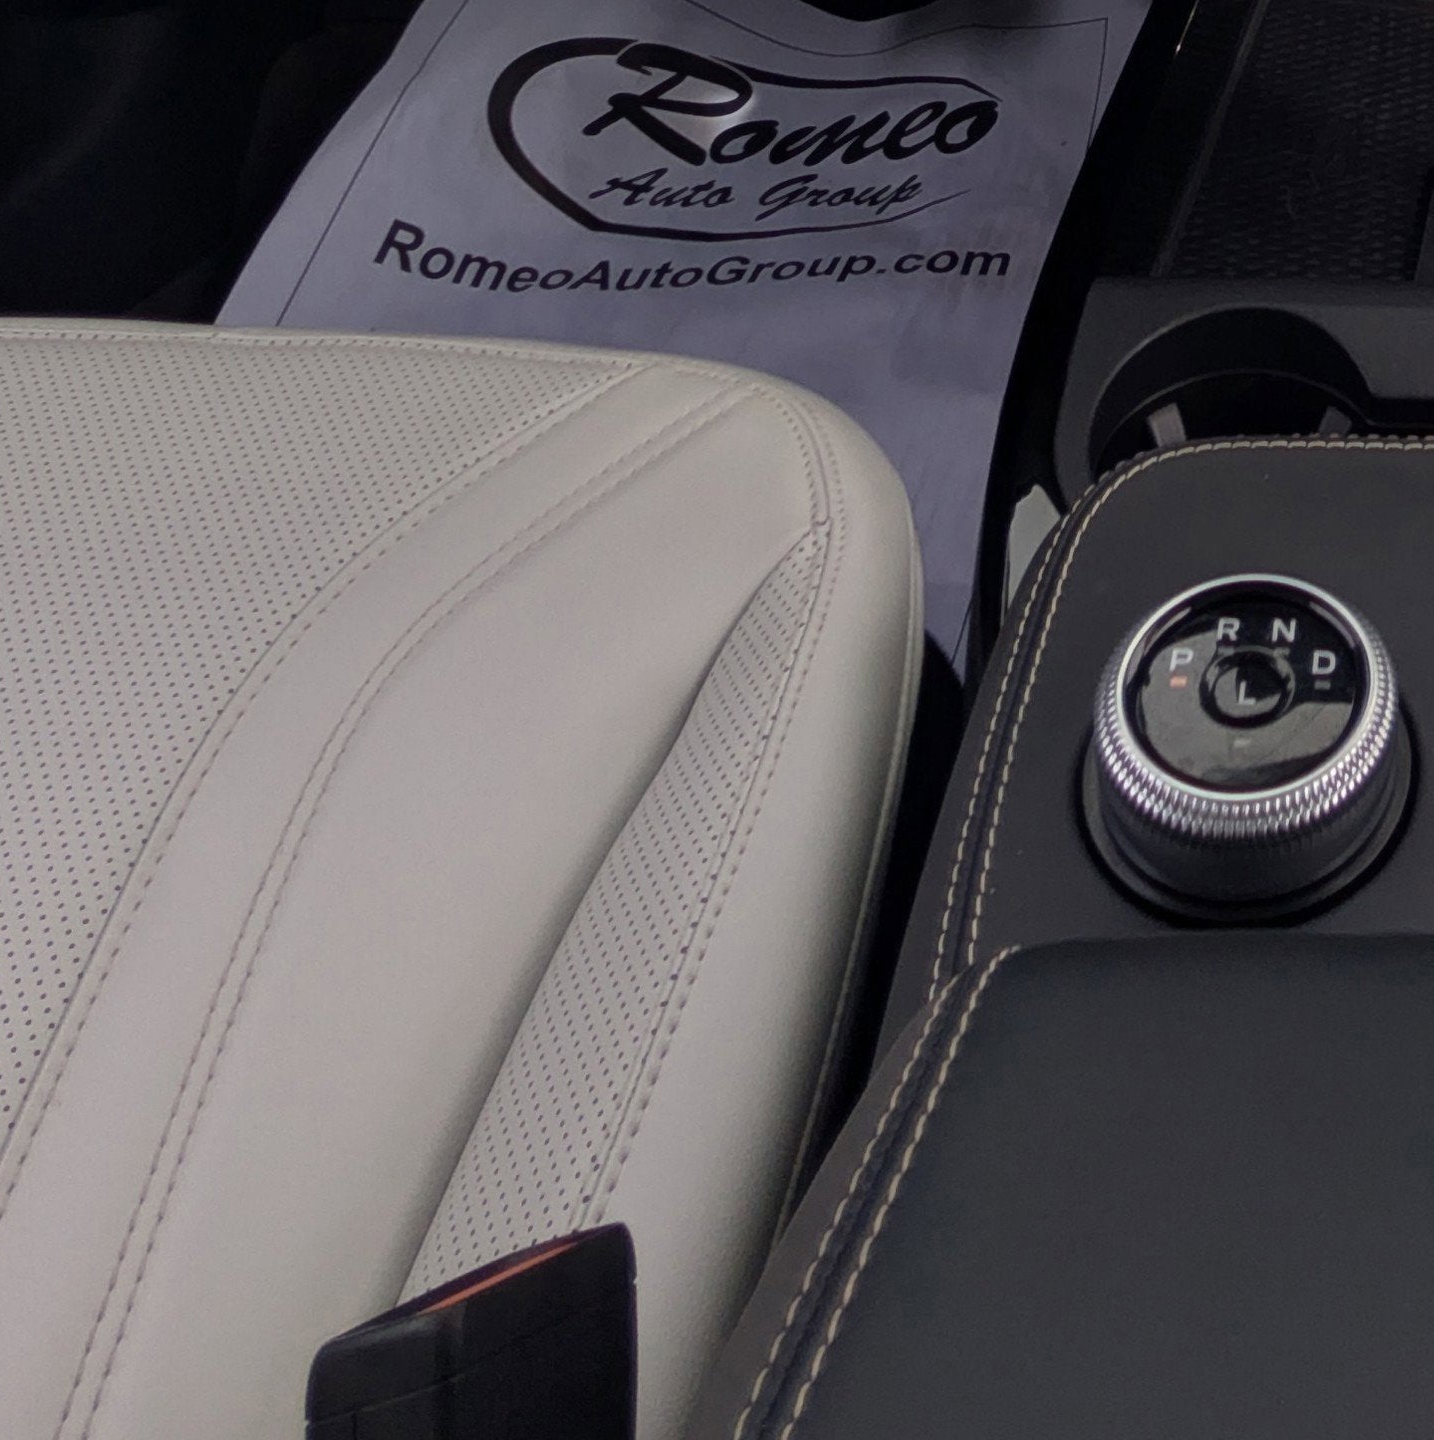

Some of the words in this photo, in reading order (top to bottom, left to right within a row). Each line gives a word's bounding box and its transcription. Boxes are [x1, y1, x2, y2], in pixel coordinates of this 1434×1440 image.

[582, 43, 1000, 167] Romeo
[591, 167, 735, 209] Auto
[755, 175, 933, 223] Group
[372, 218, 1012, 294] RomeoAutoGroup.com
[1217, 617, 1240, 643] R
[1272, 618, 1297, 643] N
[1169, 648, 1194, 673] P
[1313, 650, 1337, 675] D
[1237, 680, 1255, 706] L
